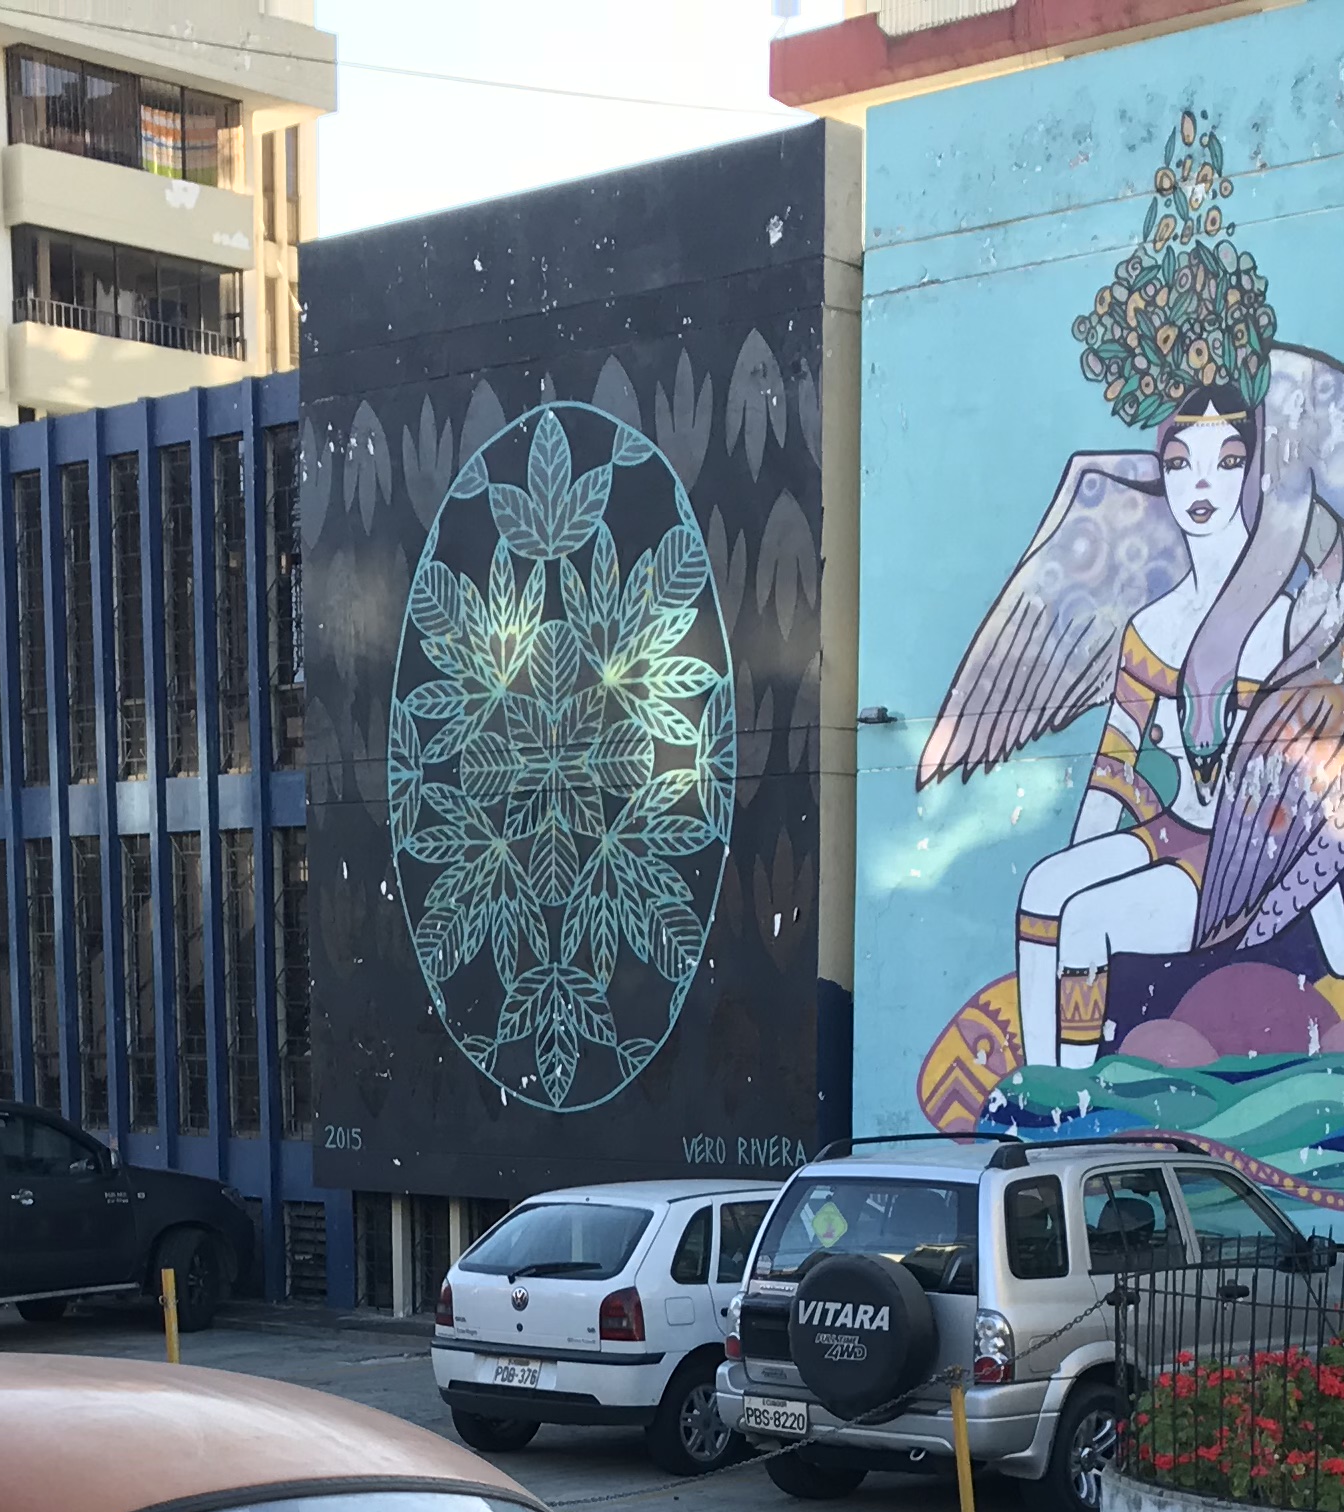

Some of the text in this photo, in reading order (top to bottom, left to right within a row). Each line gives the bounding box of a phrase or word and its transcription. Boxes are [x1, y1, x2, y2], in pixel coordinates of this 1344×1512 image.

[324, 1125, 362, 1151] 2015
[682, 1132, 808, 1167] VERO RIVERA
[798, 1300, 890, 1331] VITARA
[824, 1343, 868, 1361] 4WD
